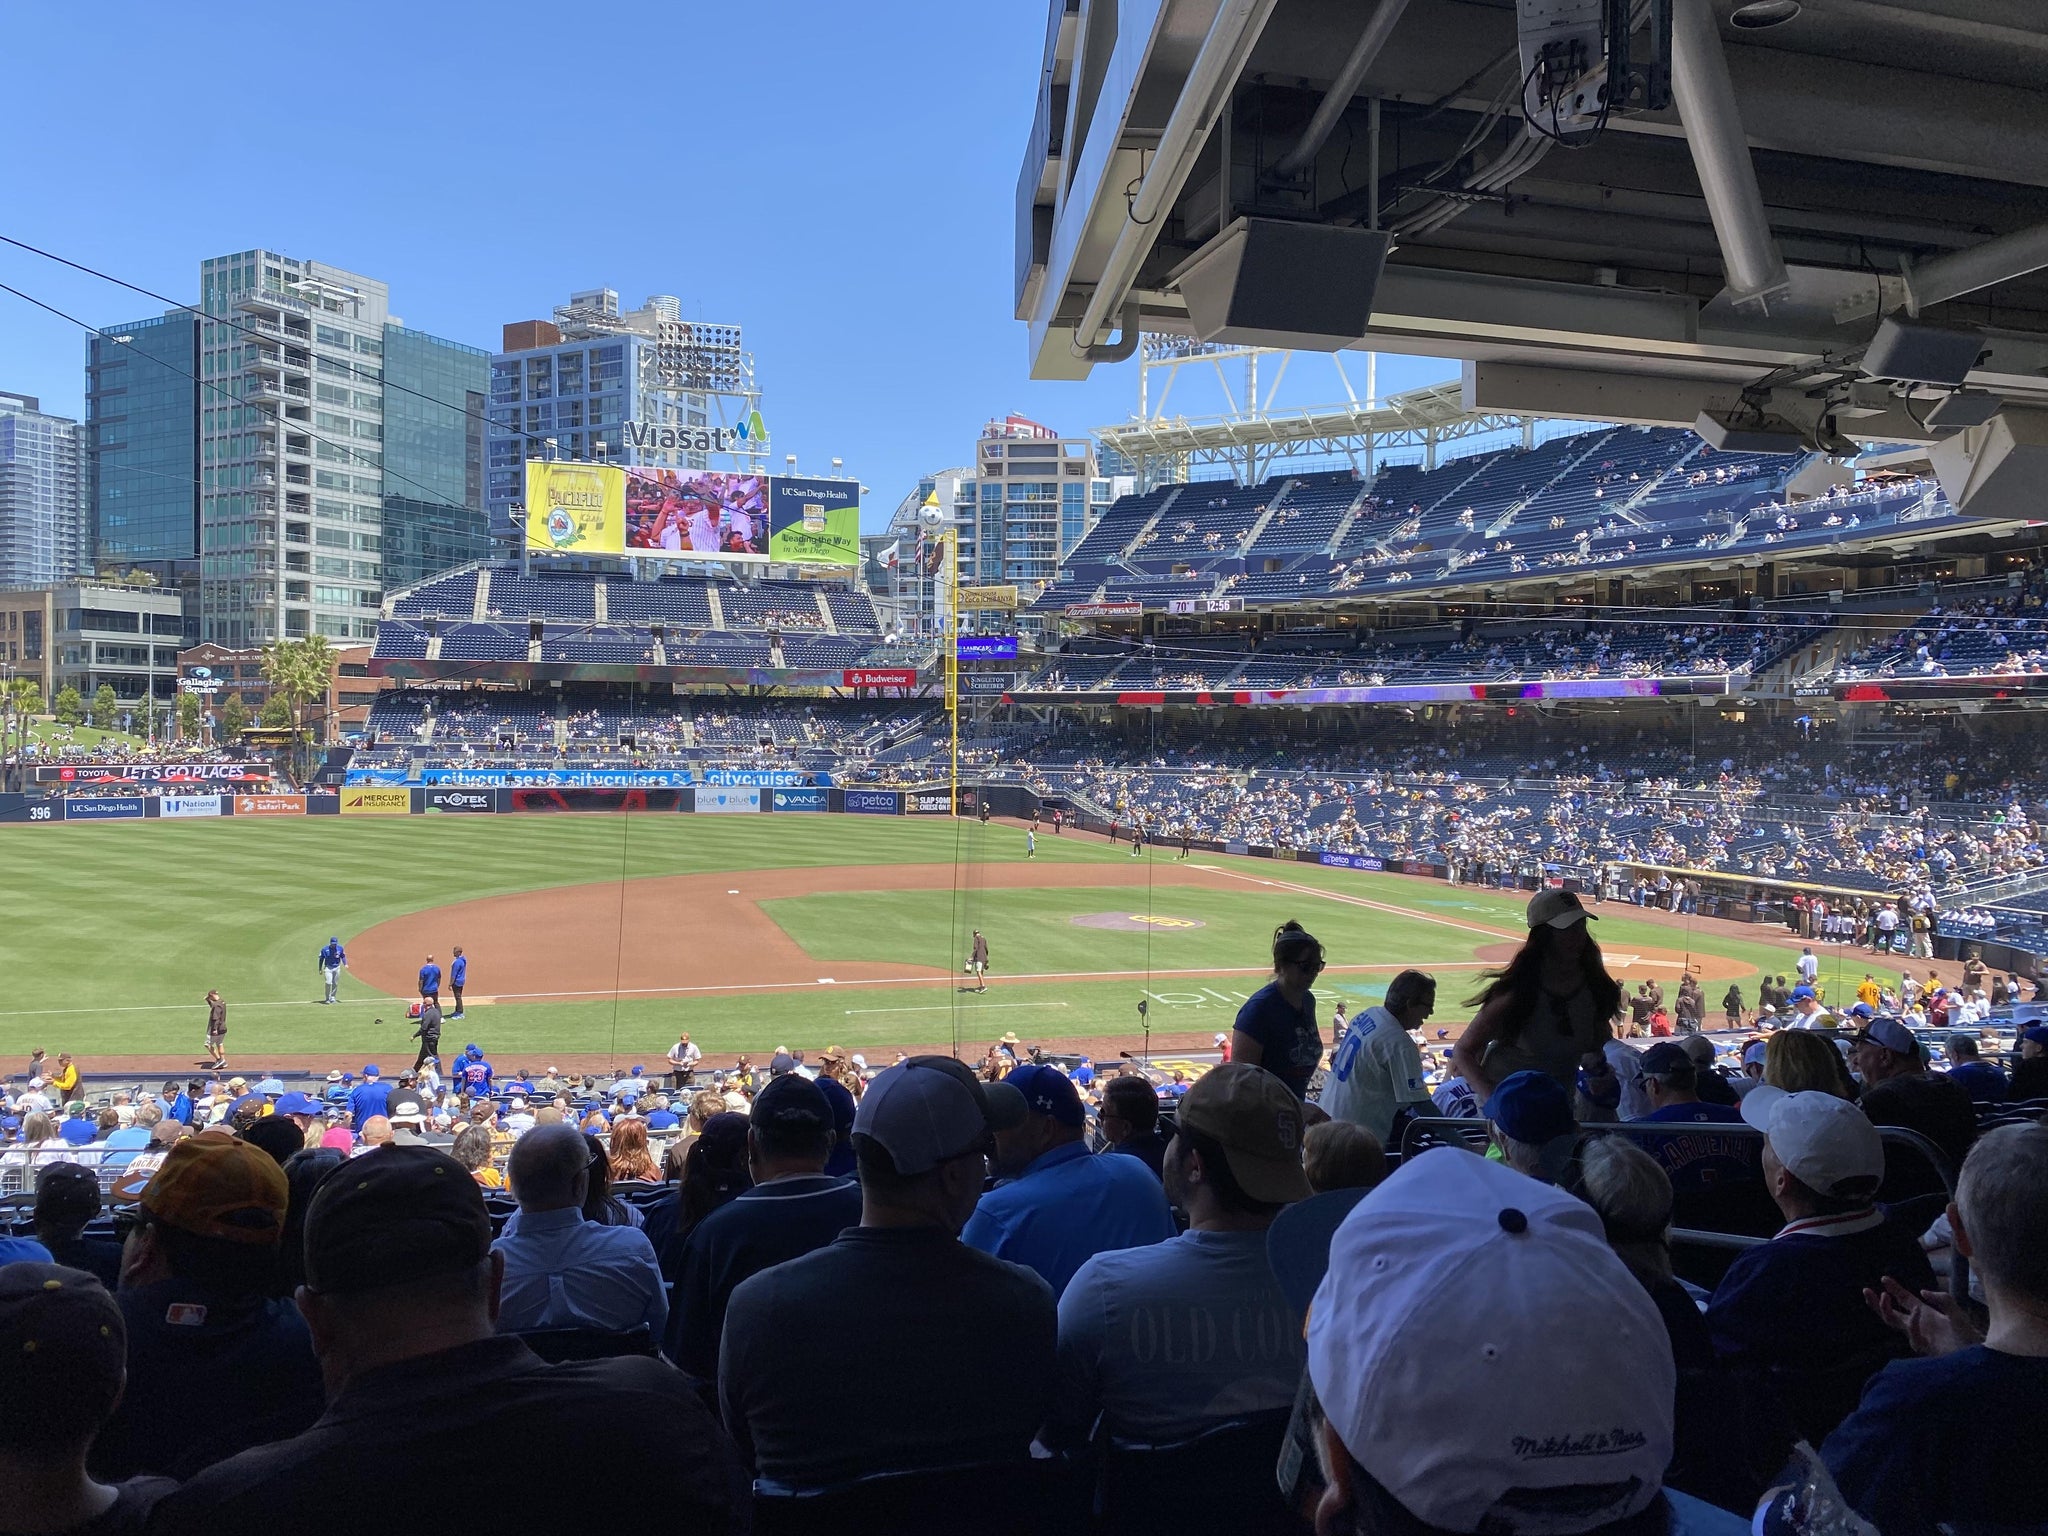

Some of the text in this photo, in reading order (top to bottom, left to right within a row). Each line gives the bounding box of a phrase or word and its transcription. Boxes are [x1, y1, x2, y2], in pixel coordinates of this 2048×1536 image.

[628, 421, 728, 451] Viasat
[782, 487, 848, 499] UC San Diego Health
[782, 533, 851, 546] Leading the Way
[783, 545, 790, 553] in
[810, 546, 830, 555] Diego
[1206, 600, 1230, 611] 12:56
[177, 678, 224, 688] Gallagher
[865, 674, 907, 683] Budweiser
[185, 686, 218, 694] Square
[122, 767, 162, 779] LET'S
[164, 766, 189, 778] GO
[191, 765, 245, 779] PLACES
[182, 800, 217, 808] National
[434, 793, 488, 806] EVOTEK
[697, 795, 717, 803] blue
[729, 795, 750, 803] blue
[787, 795, 827, 803] VANDA
[861, 794, 894, 806] petco
[30, 807, 51, 819] 396
[97, 804, 117, 812] Diego
[118, 803, 138, 811] Health
[1330, 855, 1350, 865] petco
[1362, 858, 1382, 868] petco
[1140, 987, 1343, 1004] ble
[1869, 988, 1877, 996] 19
[467, 1070, 485, 1083] 23
[129, 1160, 161, 1171] MACHA
[1131, 1306, 1218, 1363] OLD
[1511, 1433, 1596, 1455] Mitchell
[1610, 1428, 1647, 1447] Ness
